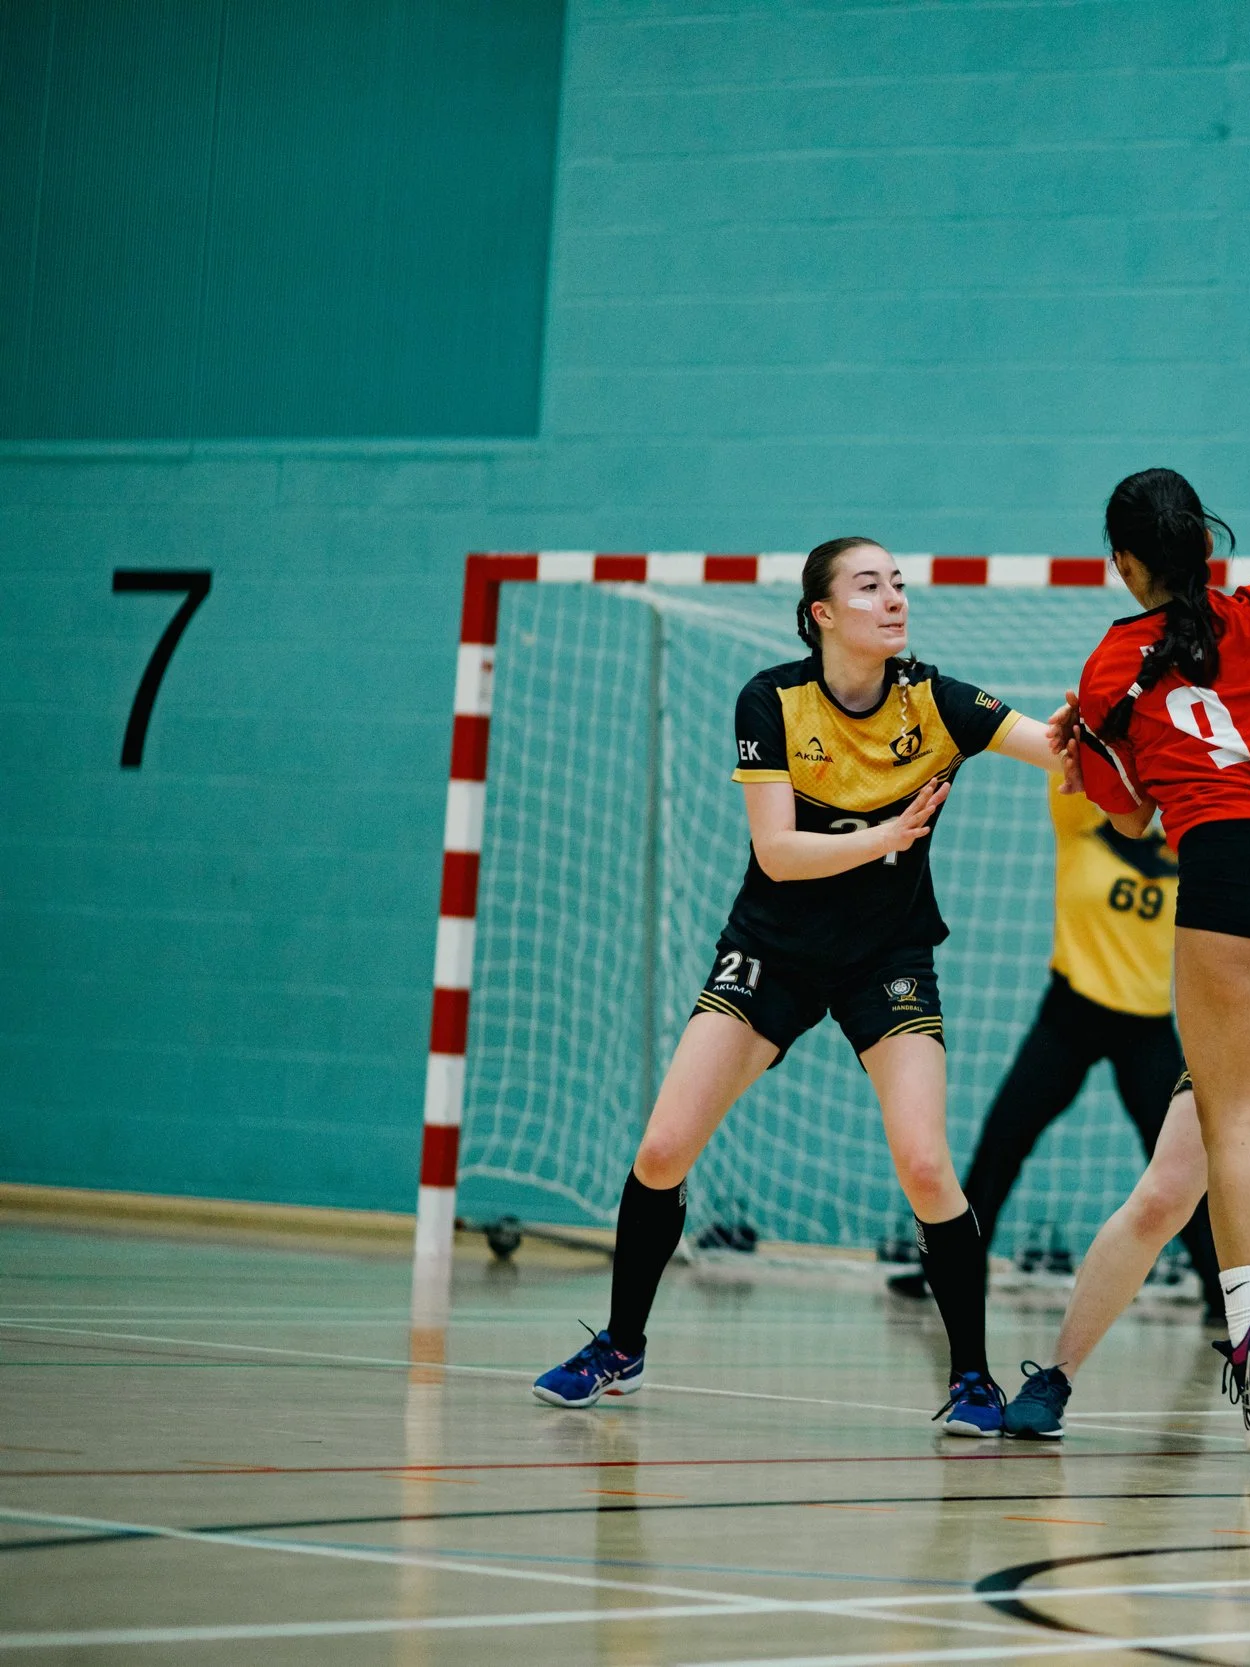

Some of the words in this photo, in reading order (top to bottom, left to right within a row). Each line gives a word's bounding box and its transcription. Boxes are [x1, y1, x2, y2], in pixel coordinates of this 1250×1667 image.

[112, 567, 212, 770] 7
[793, 751, 835, 764] AKUMA
[1107, 876, 1165, 921] 69
[714, 949, 762, 990] 21
[712, 983, 753, 998] AKUMA
[891, 1004, 924, 1013] HANDBALL
